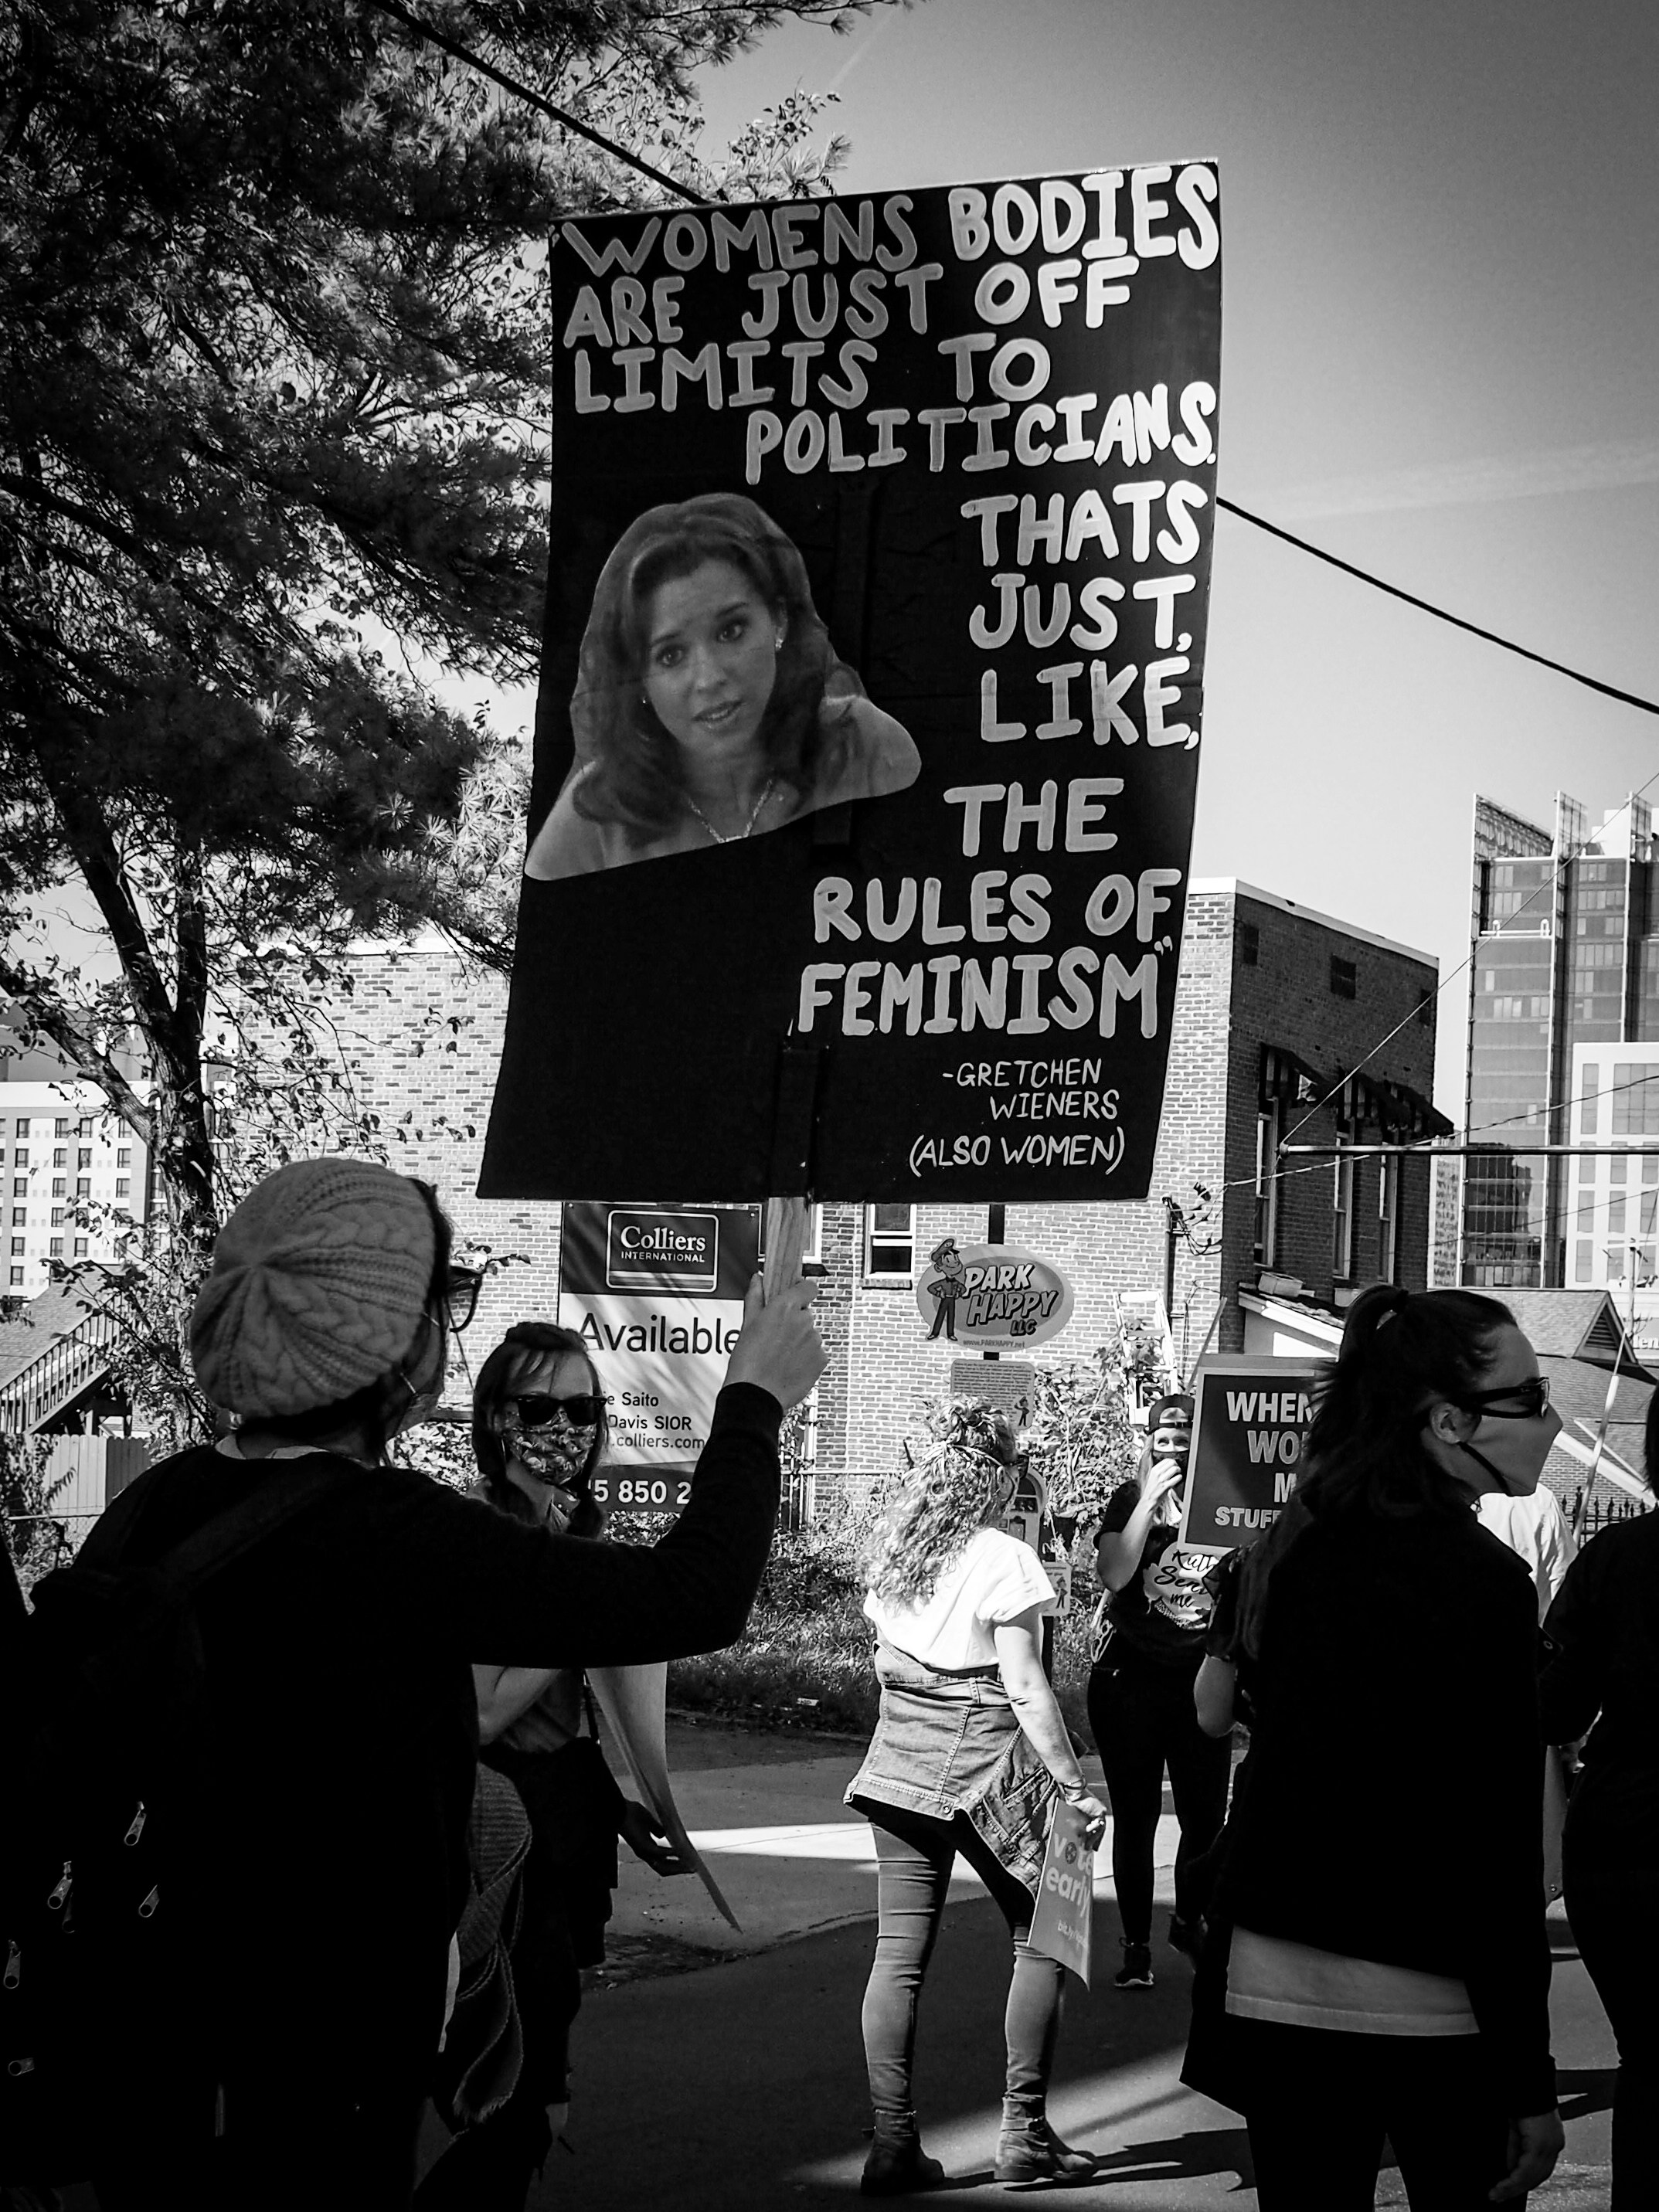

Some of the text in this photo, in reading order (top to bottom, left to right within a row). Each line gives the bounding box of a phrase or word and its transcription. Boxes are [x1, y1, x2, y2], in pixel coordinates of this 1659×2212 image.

[948, 165, 1219, 270] BODIES
[563, 257, 1140, 348] ARE JUST OFF
[575, 332, 1050, 413] LIMITS TO
[746, 382, 1216, 484] POLITICIANS.
[961, 480, 1208, 566] THATS
[943, 778, 1124, 857] THE
[814, 868, 1181, 945] RULES OF
[943, 1058, 1101, 1088] -GRETCHEN
[990, 1089, 1120, 1120] WIENERS
[909, 1126, 1124, 1177] (ALSO WOMEN)
[620, 1225, 705, 1252] Colliers
[620, 1251, 705, 1262] INTERNATIONAL
[961, 1263, 1035, 1300] PARK
[967, 1290, 1059, 1327] HAPPY
[580, 1313, 741, 1355] Available
[1010, 1319, 1037, 1337] LLC
[622, 1392, 659, 1407] Saito
[608, 1415, 692, 1430] Davis SIOR
[588, 1480, 609, 1502] 5
[618, 1480, 667, 1504] 850
[1171, 1594, 1195, 1607] me
